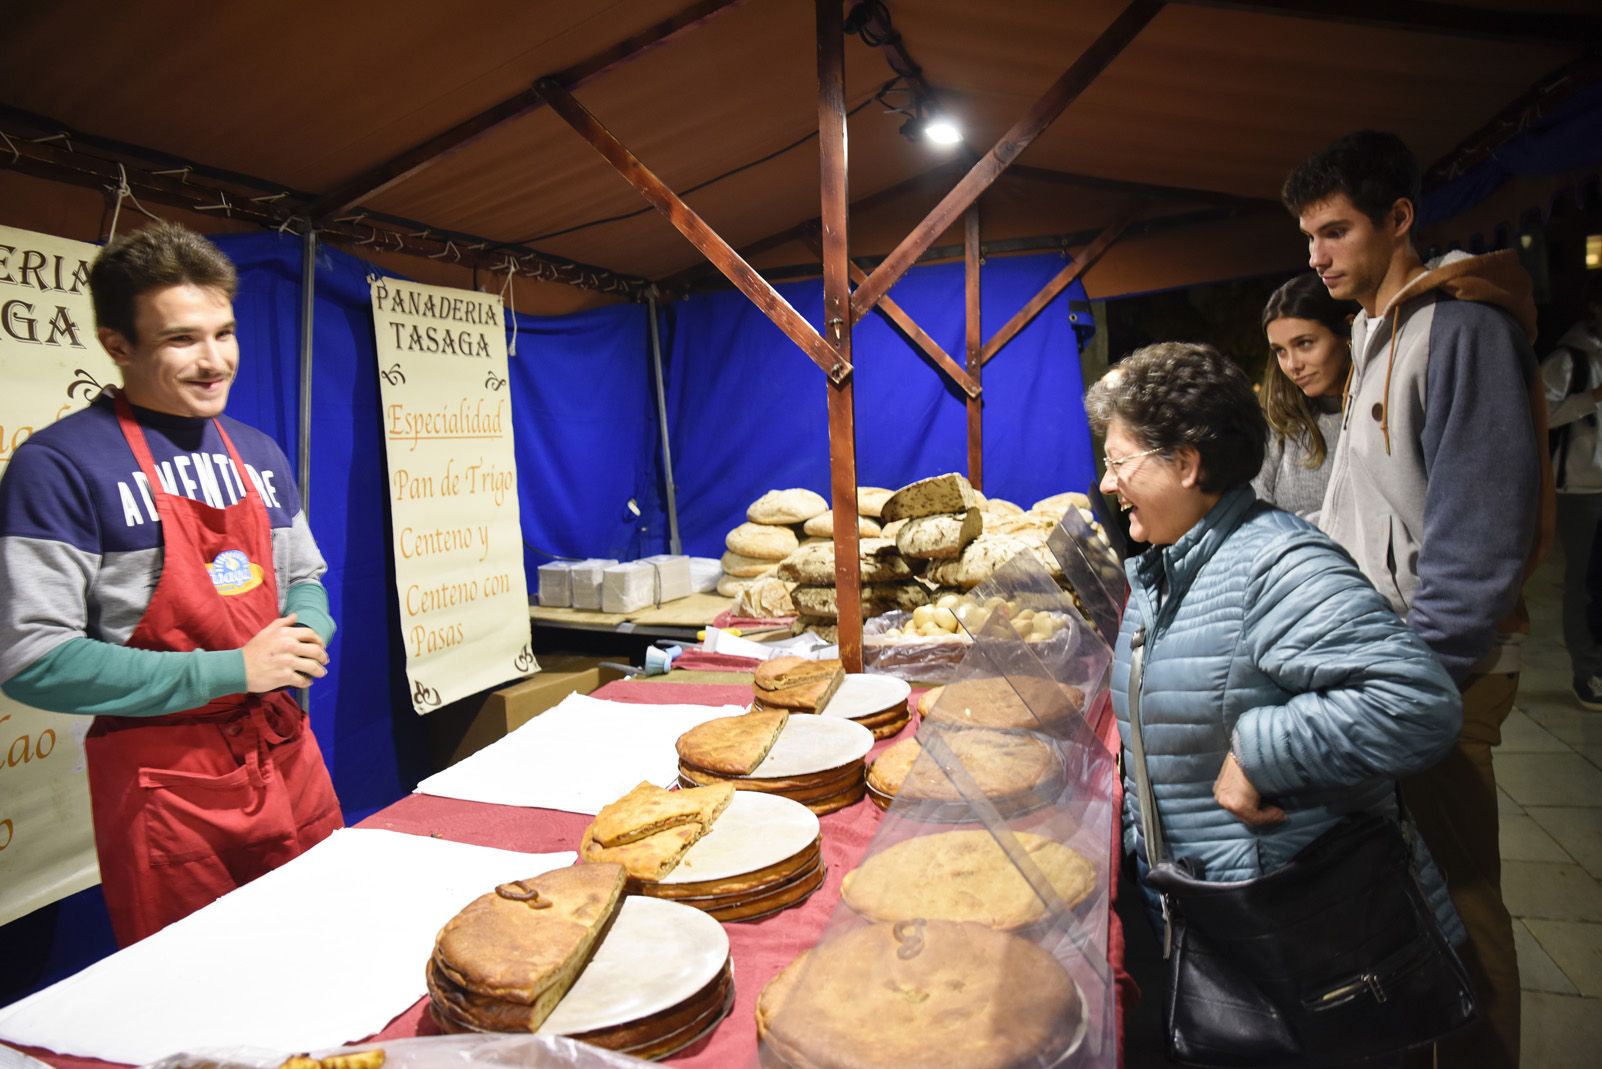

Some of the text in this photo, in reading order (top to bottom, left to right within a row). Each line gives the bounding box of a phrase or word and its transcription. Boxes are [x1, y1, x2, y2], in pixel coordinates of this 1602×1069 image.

[376, 285, 500, 327] PANADERIA
[389, 321, 492, 358] TASAGA
[388, 397, 505, 452] Especialidad
[393, 457, 514, 508] Pan de Trigo
[400, 523, 490, 563] Centeno y
[406, 572, 511, 617] Centeno con
[410, 621, 465, 658] Pasas
